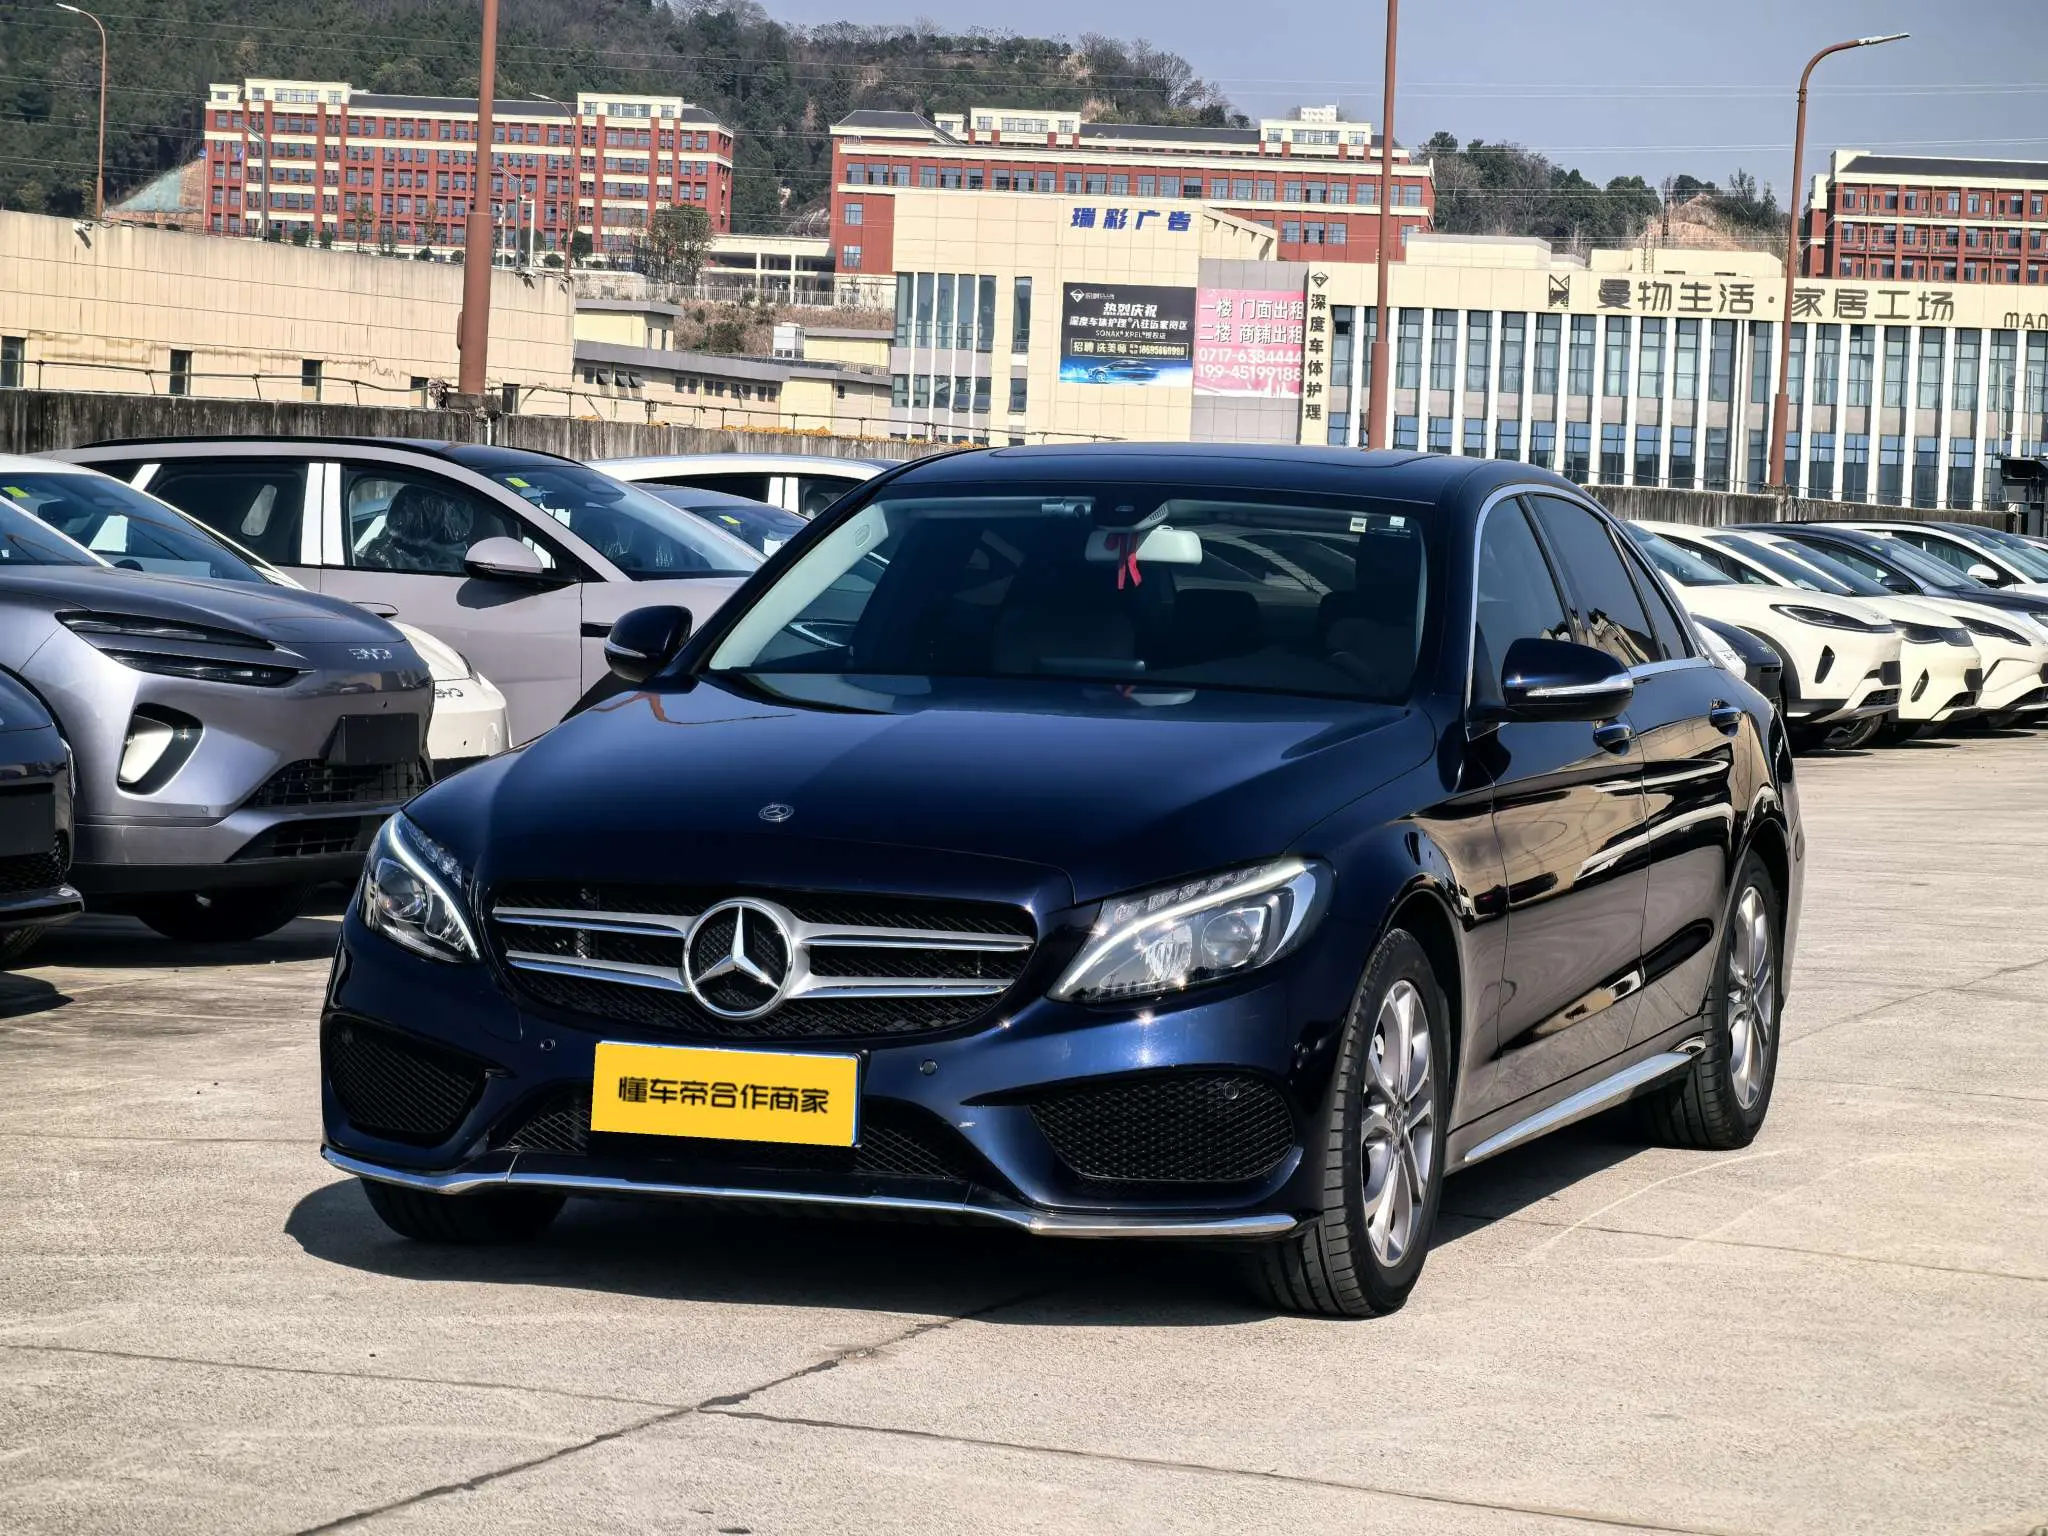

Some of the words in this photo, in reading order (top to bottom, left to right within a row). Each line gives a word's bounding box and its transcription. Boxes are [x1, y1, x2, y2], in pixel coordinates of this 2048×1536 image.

[1070, 207, 1192, 232] 瑞彩广告
[1102, 302, 1158, 318] 热烈庆祝
[1200, 297, 1232, 319] 一楼
[1240, 298, 1305, 321] 门面出租
[1199, 322, 1232, 343] 二楼
[1239, 323, 1304, 345] 商铺出租
[1073, 341, 1094, 353] 招聘
[1199, 347, 1302, 365] 0717-6384444
[1305, 293, 1327, 421] 深度车体护理
